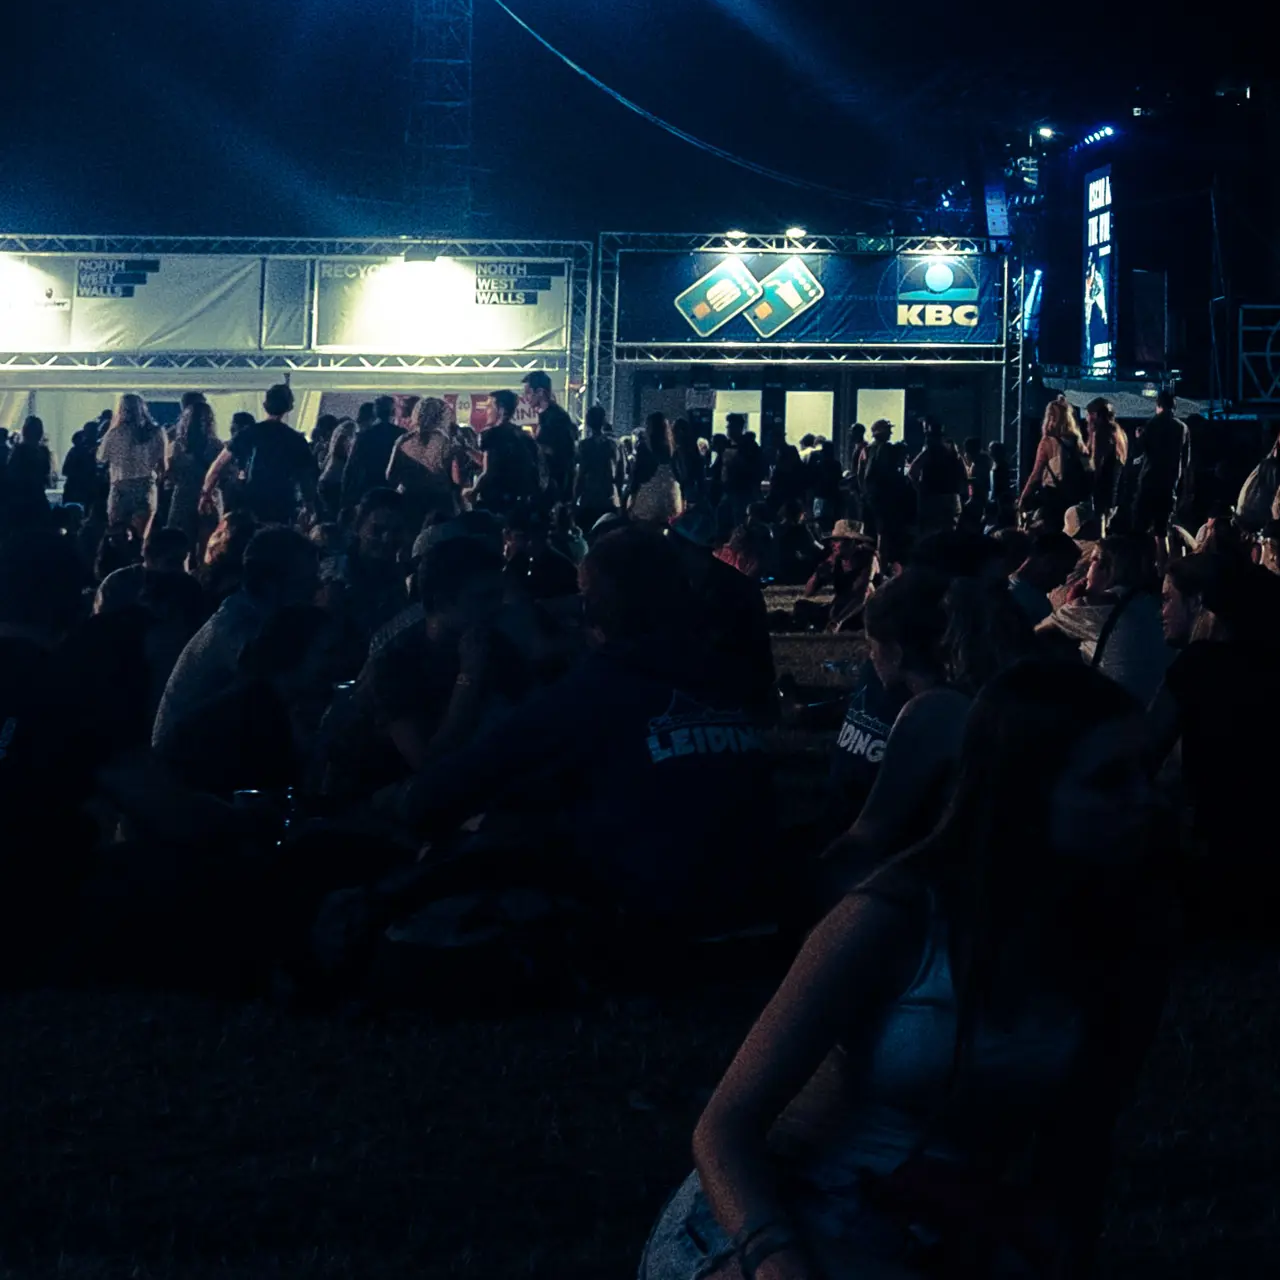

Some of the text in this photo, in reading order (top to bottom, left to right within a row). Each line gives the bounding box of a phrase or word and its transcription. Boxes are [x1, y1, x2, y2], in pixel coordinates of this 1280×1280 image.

[79, 260, 125, 271] NORTH
[476, 263, 527, 276] NORTH
[79, 272, 116, 284] WEST
[476, 277, 518, 290] WEST
[79, 285, 123, 297] WALLS
[476, 291, 526, 304] WALLS
[896, 304, 980, 327] KBC
[646, 724, 763, 765] LEIDIN
